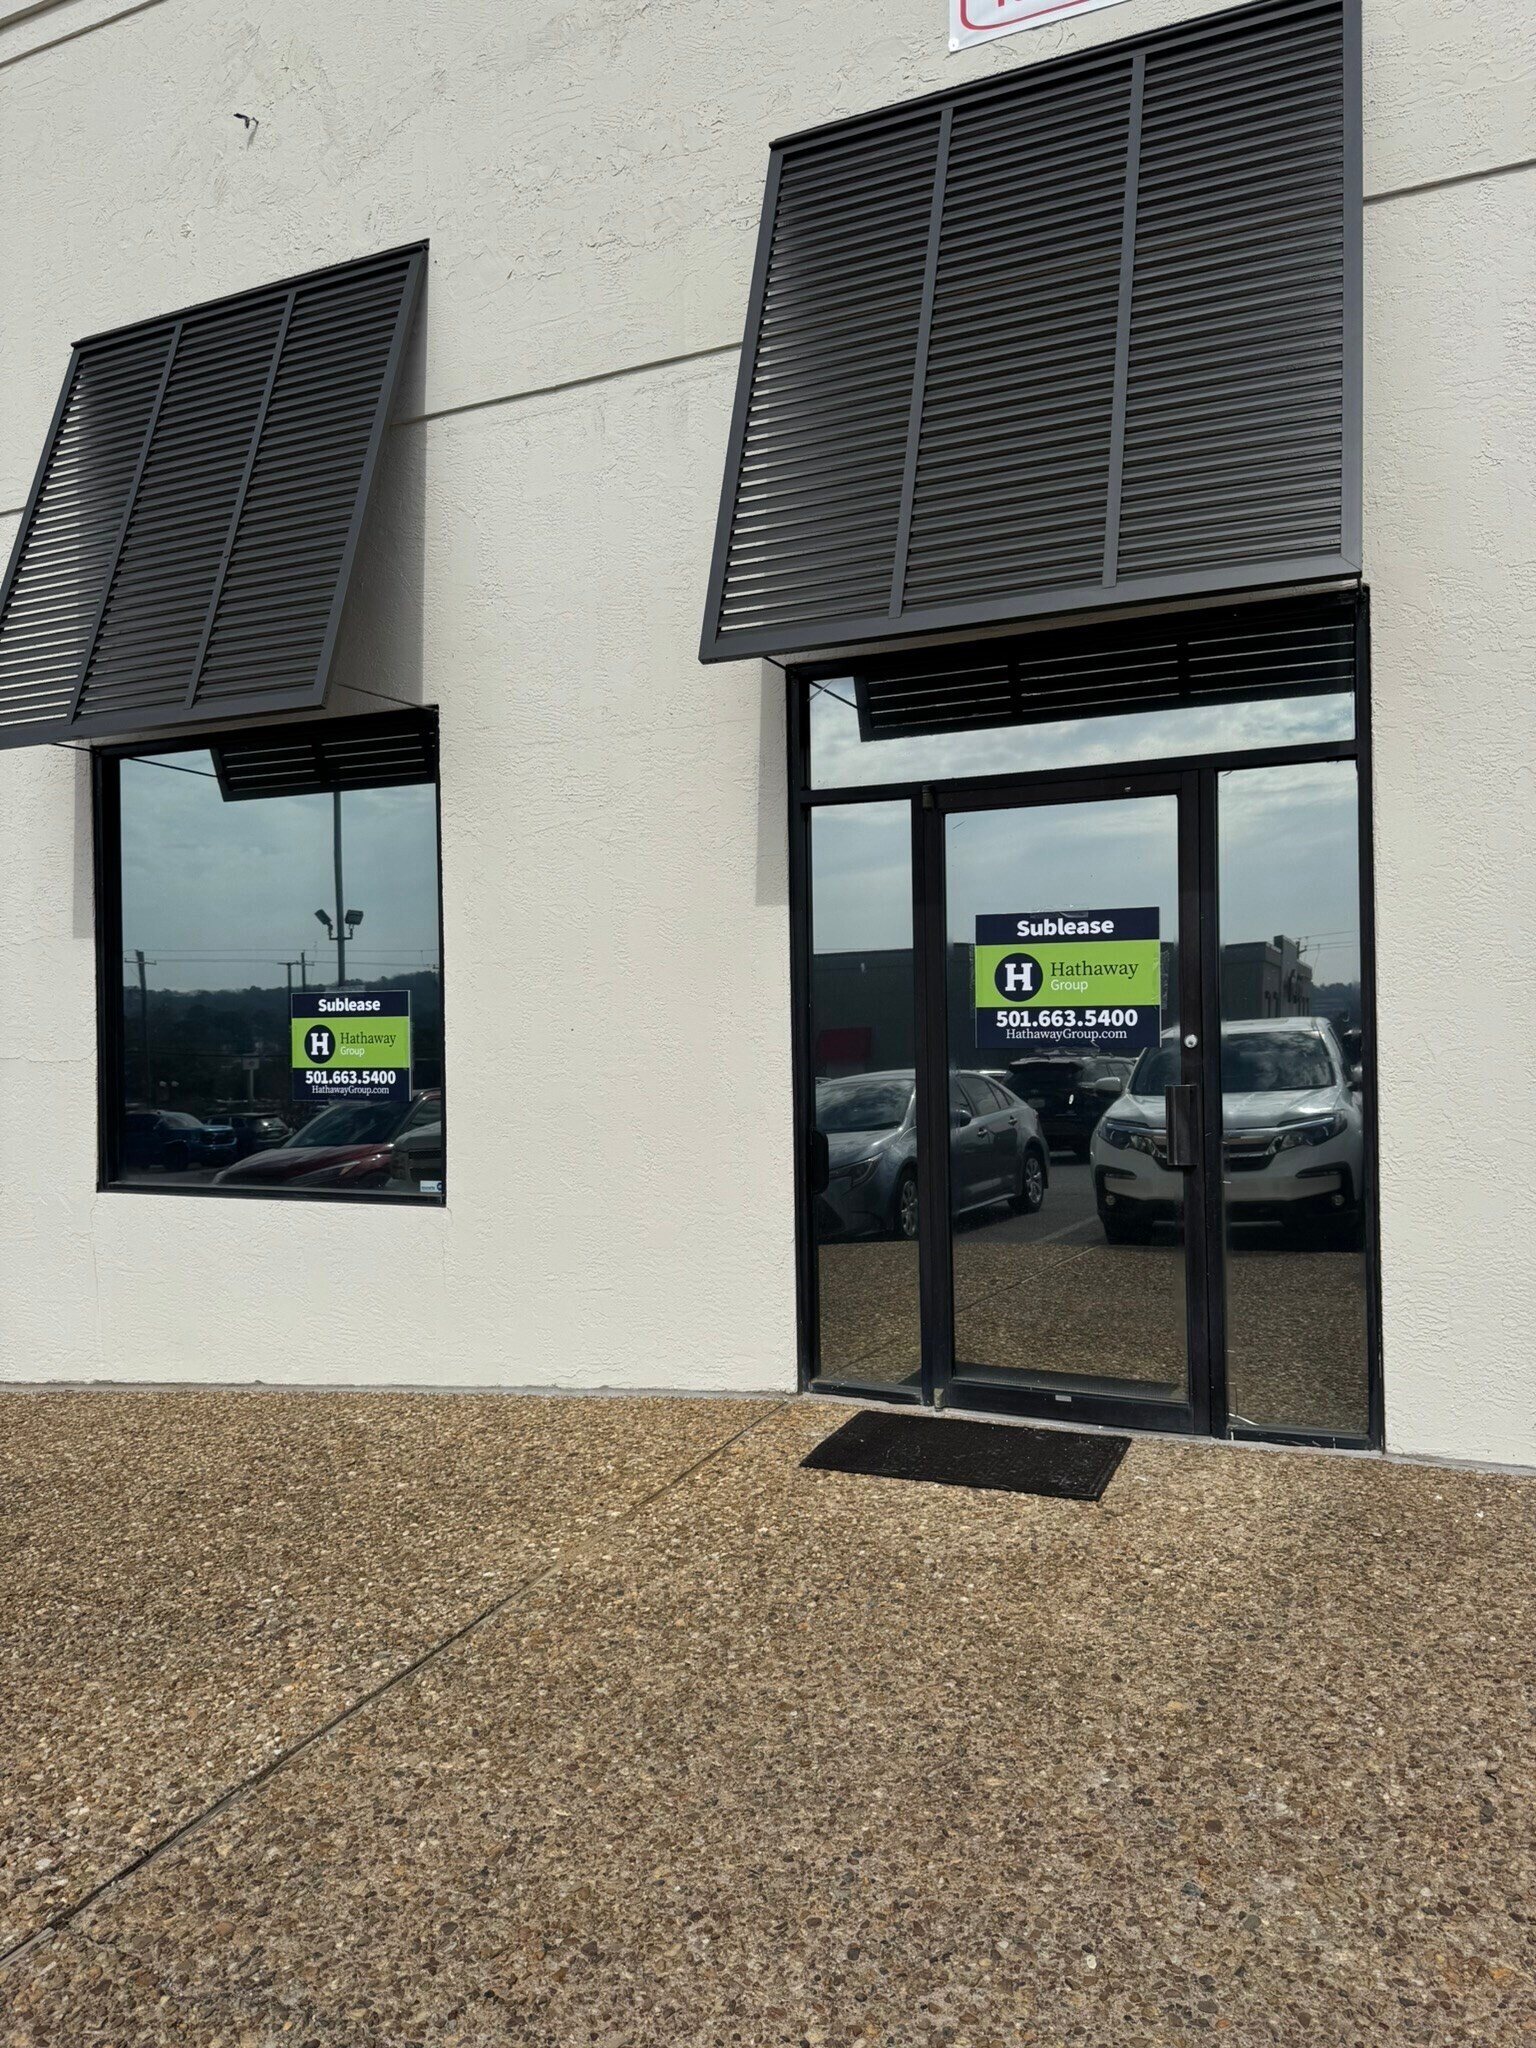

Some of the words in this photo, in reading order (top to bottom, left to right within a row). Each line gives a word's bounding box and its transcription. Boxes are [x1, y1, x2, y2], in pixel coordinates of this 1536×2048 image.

[1016, 917, 1115, 937] Sublease
[1004, 962, 1033, 991] H
[1050, 960, 1139, 979] Hathaway
[1050, 979, 1089, 992] Group
[318, 998, 381, 1012] Sublease
[996, 1009, 1138, 1027] 501.663.5400
[340, 1032, 396, 1047] Hathaway
[1006, 1028, 1127, 1041] HathawayGroup.com
[310, 1032, 329, 1055] H
[340, 1046, 365, 1057] Group
[305, 1070, 396, 1084] 501.663.5400
[312, 1085, 389, 1096] HathawayGroup.com
